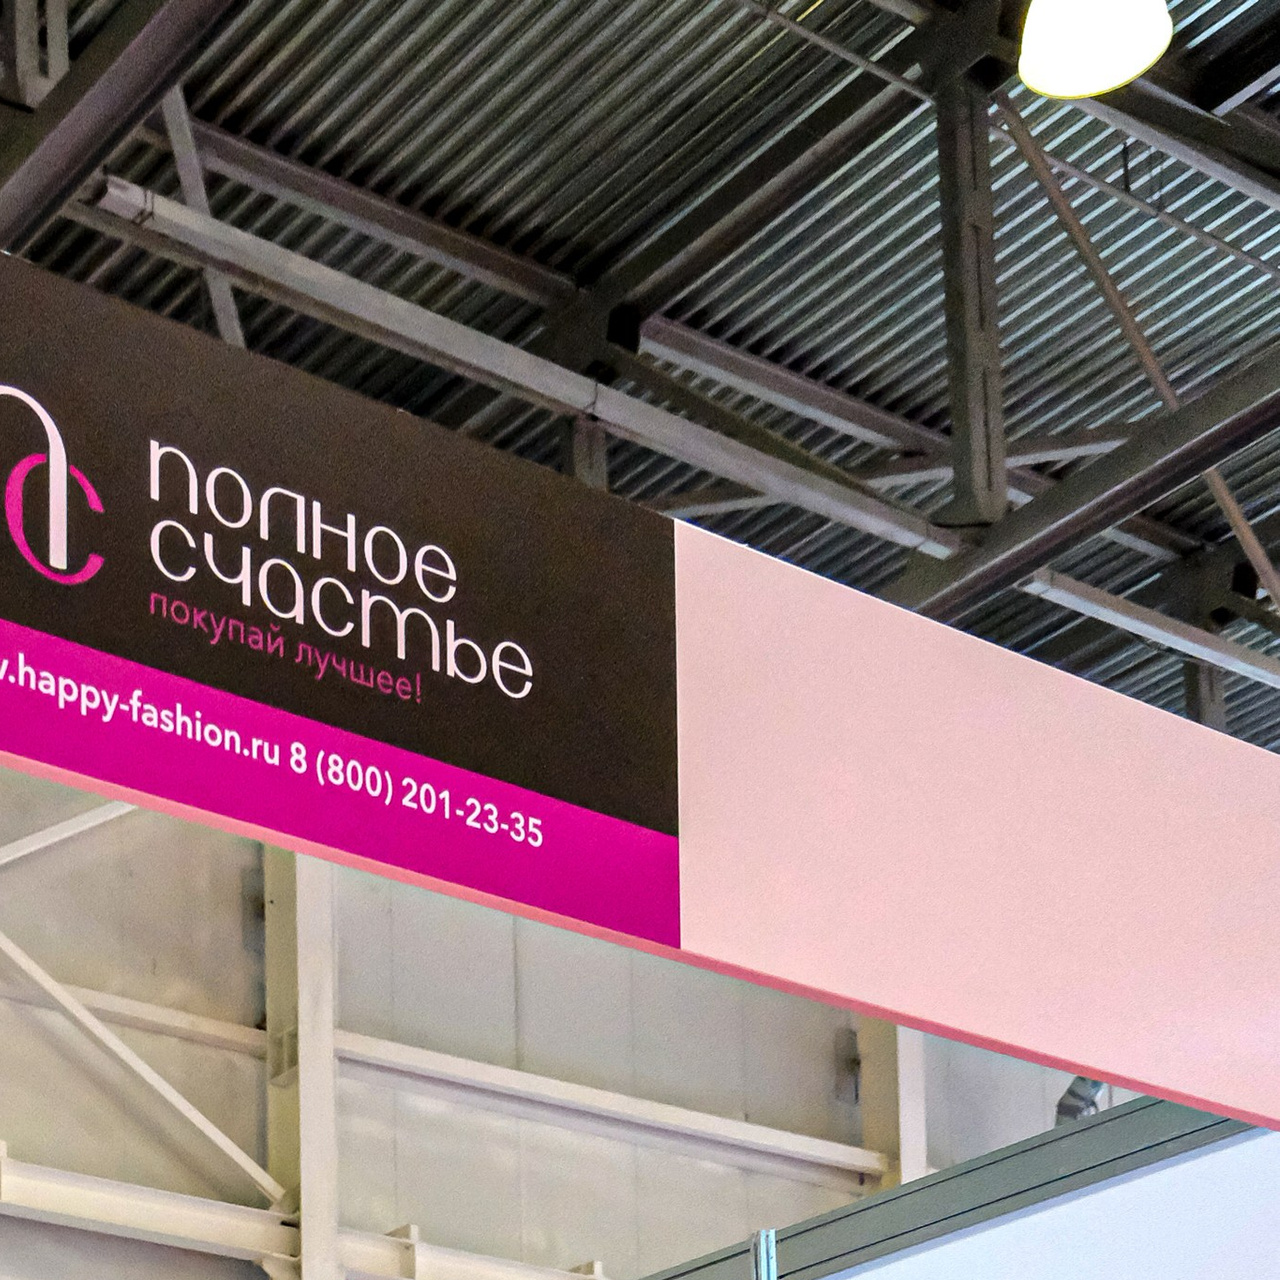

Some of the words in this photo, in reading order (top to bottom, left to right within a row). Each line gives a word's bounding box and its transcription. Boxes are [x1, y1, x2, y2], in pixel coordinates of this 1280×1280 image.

[149, 439, 458, 604] полное
[148, 592, 285, 658] покупай
[294, 640, 422, 703] лучшее!
[149, 519, 534, 699] счастье
[289, 741, 308, 774] 8
[316, 749, 393, 806] (800)
[401, 776, 544, 848] 201-23-35
